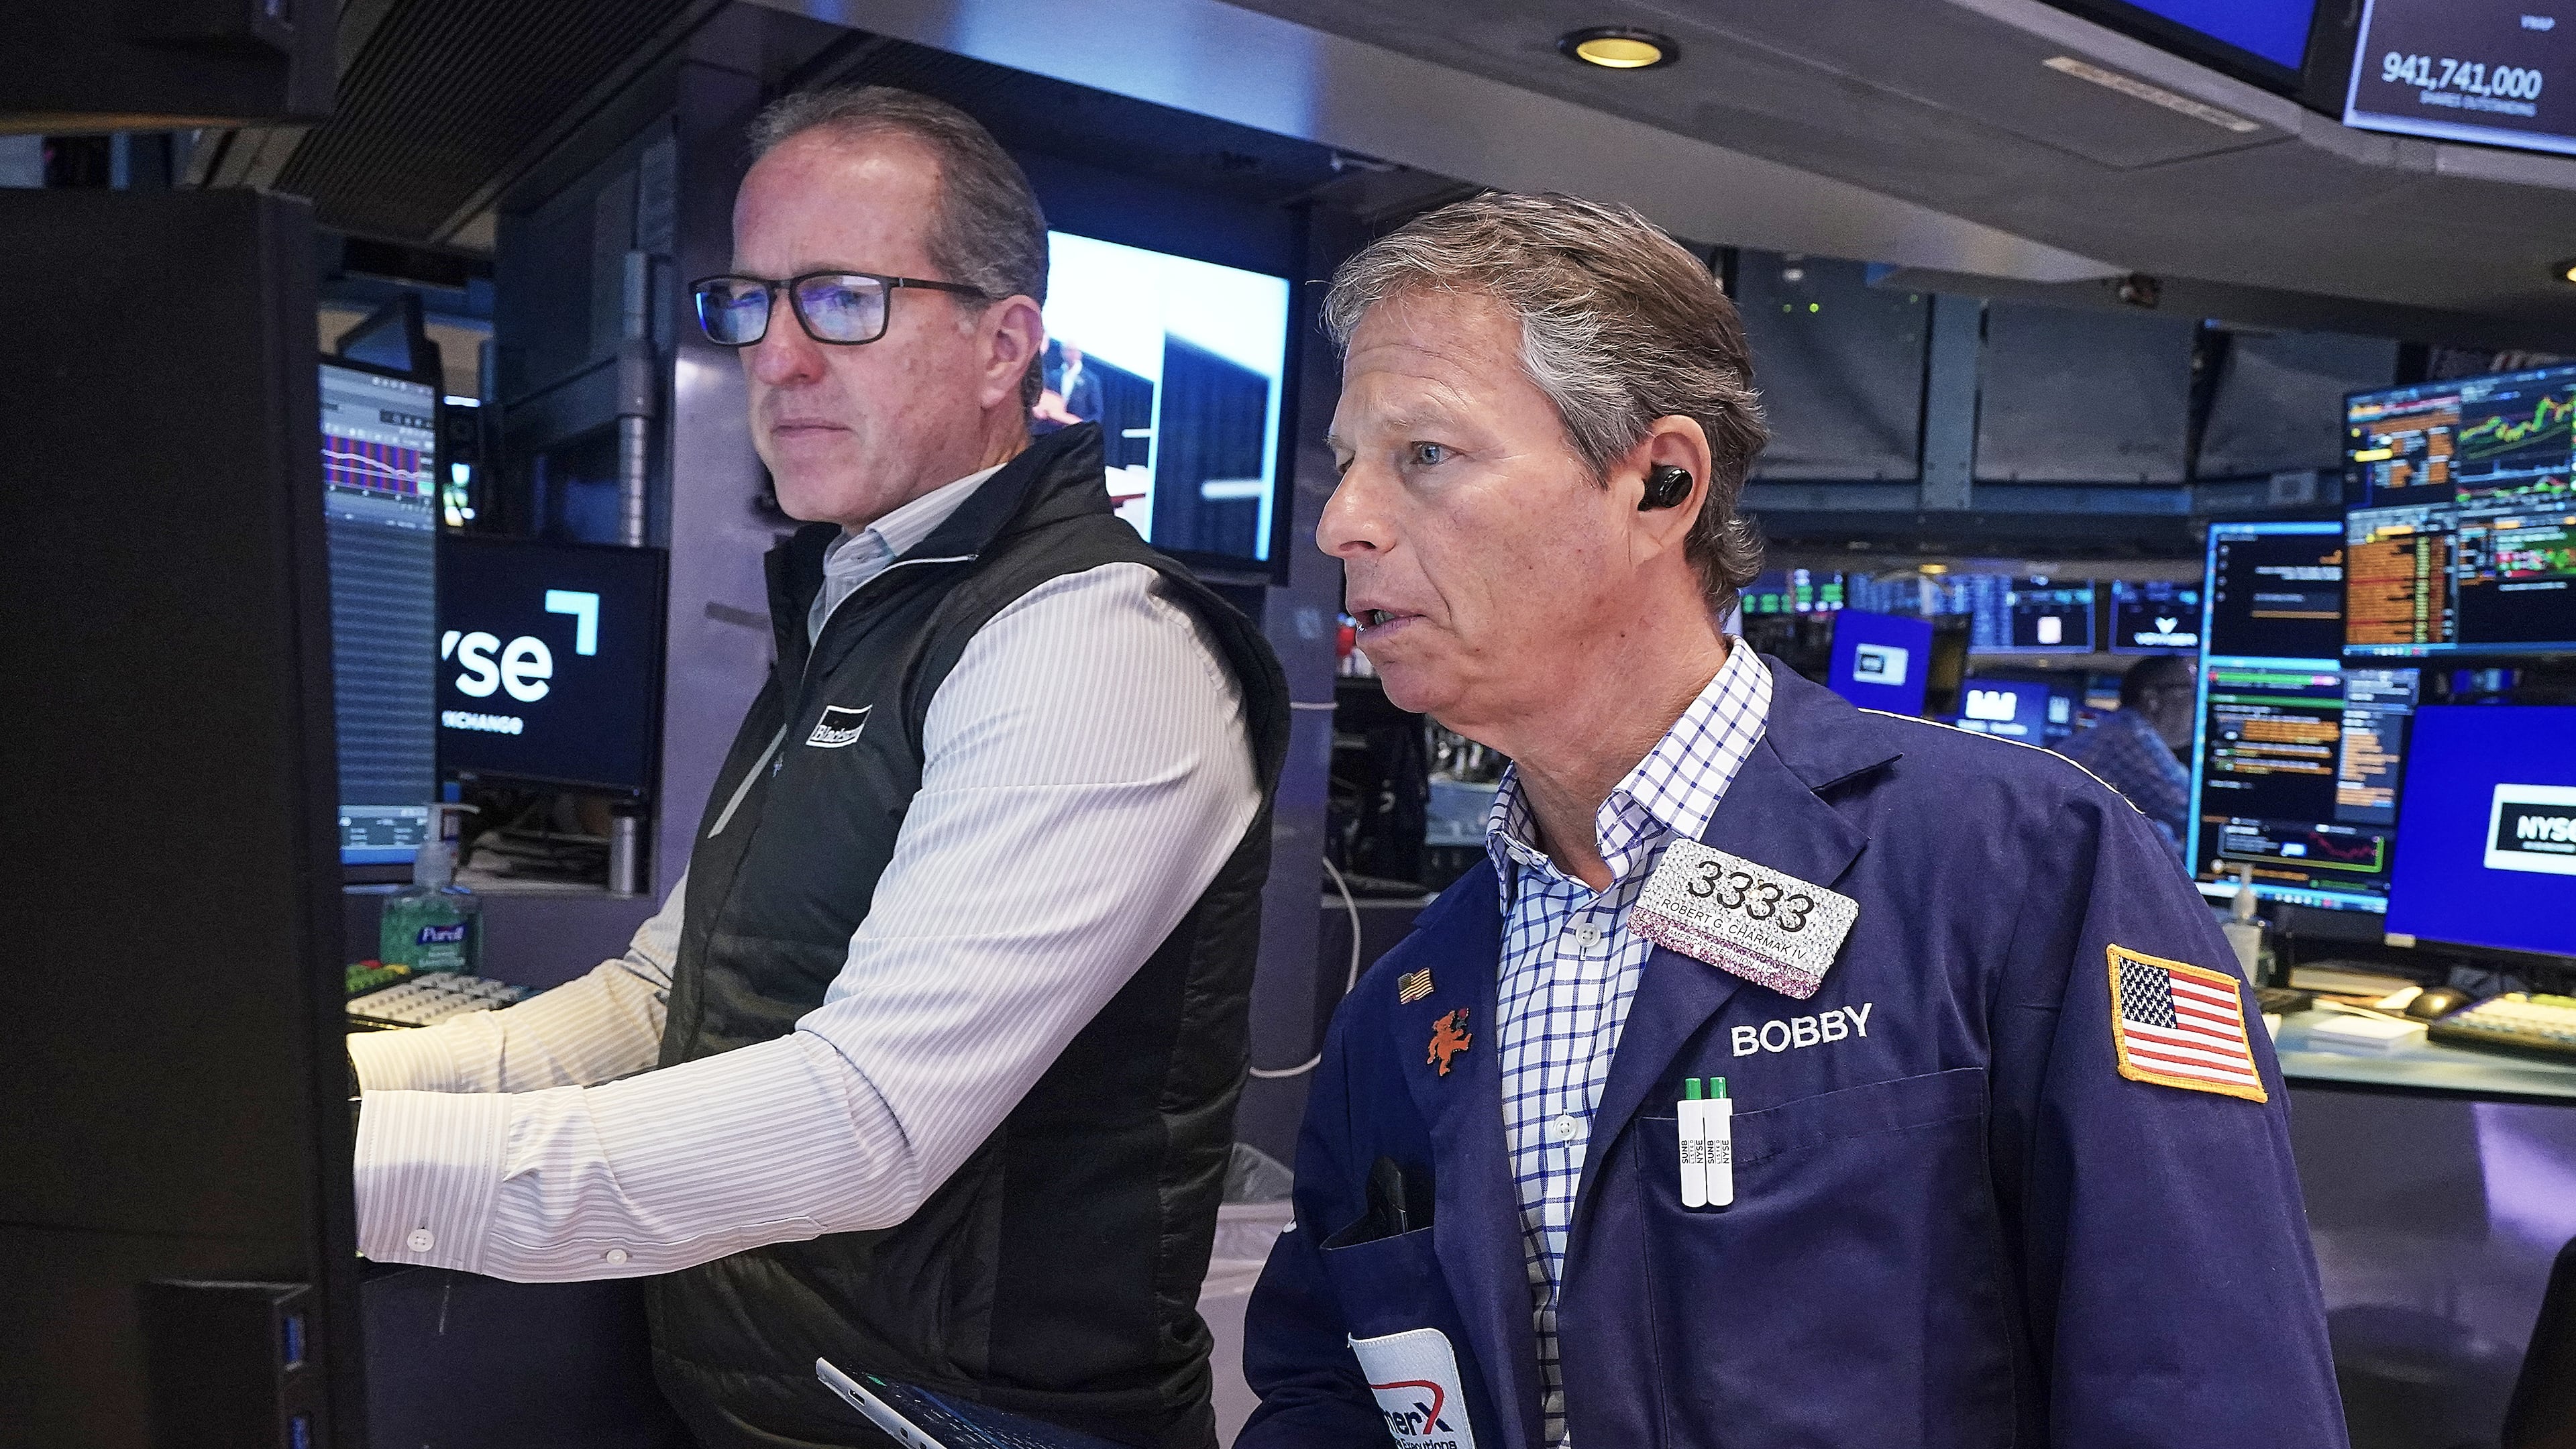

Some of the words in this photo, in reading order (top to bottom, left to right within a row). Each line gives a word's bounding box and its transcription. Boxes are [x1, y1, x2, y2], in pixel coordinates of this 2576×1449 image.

[2381, 52, 2542, 100] 941,741,000
[1688, 861, 1814, 932] 3333
[1661, 899, 1711, 924] ROBERT
[1713, 918, 1724, 929] G.
[1729, 924, 1792, 955] CHARMAK
[1792, 949, 1807, 960] IV
[1668, 929, 1709, 948] AMERICAS
[1756, 961, 1772, 973] LLC
[1731, 1002, 1872, 1057] BOBBY
[1696, 1140, 1704, 1164] NYSE
[1722, 1140, 1730, 1164] NYSE
